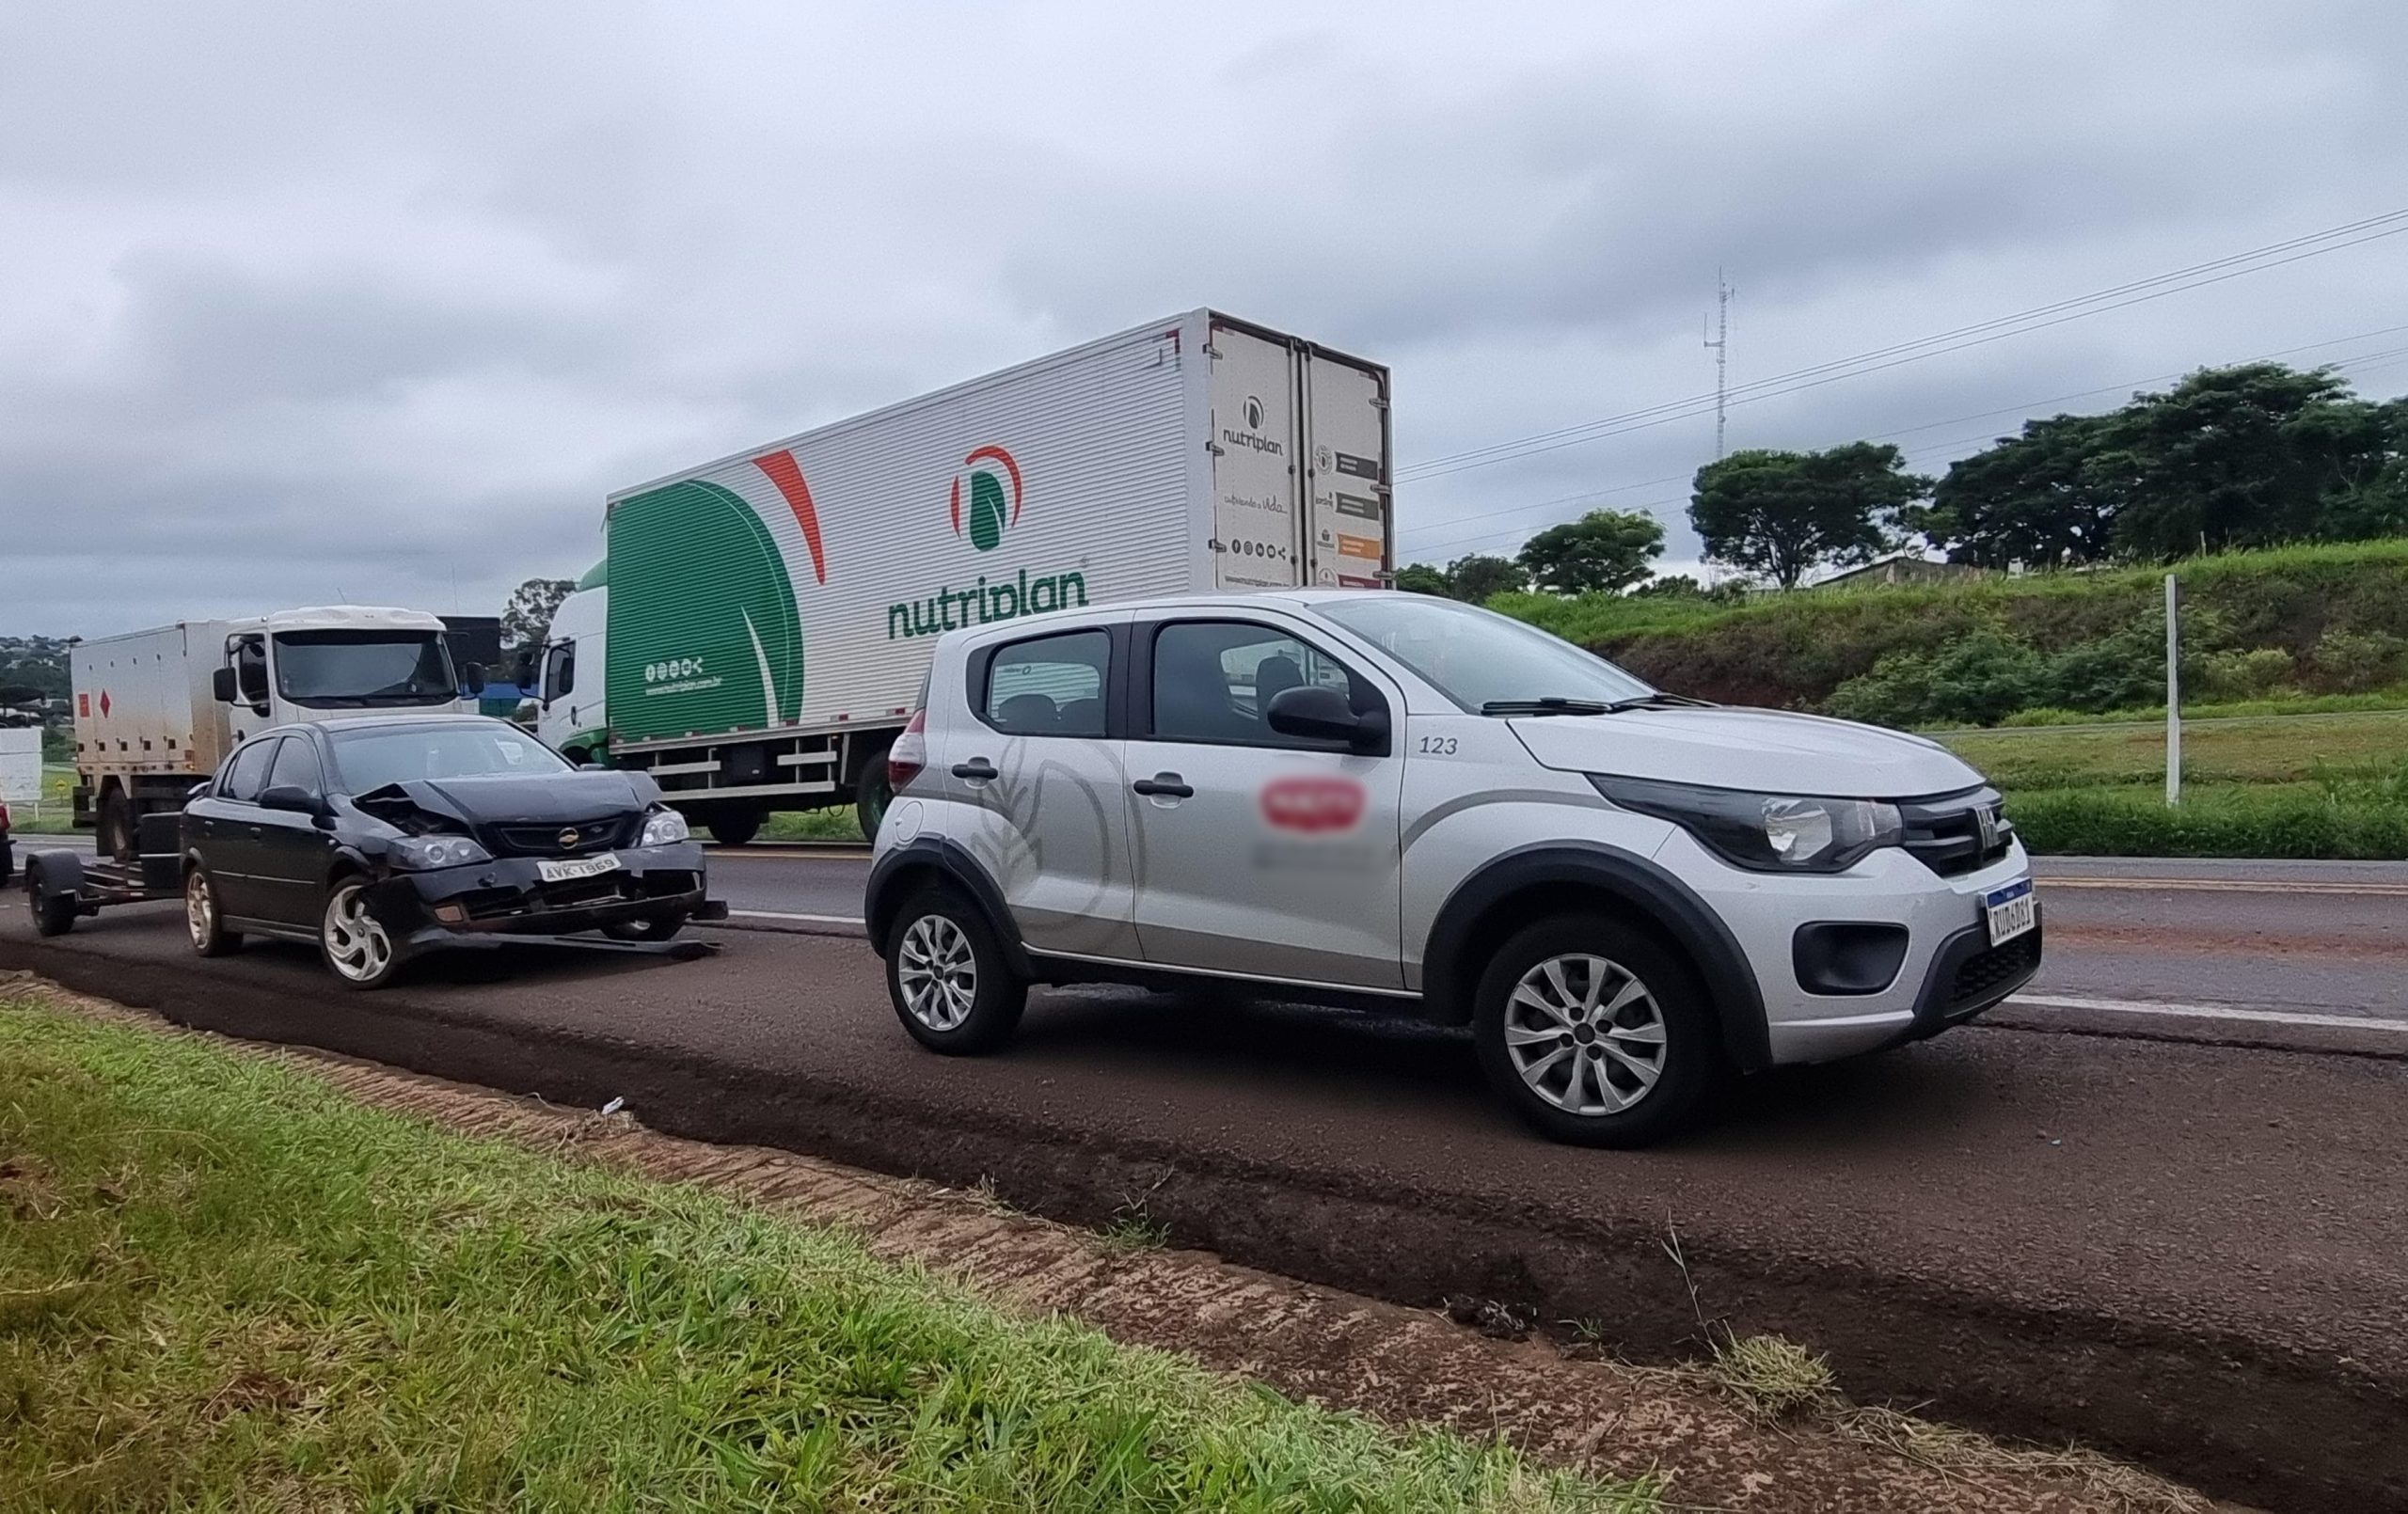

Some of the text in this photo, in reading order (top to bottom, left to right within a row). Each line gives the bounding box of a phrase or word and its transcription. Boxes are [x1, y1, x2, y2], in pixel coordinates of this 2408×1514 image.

[1223, 429, 1283, 456] nutriplan
[888, 568, 1089, 640] nutriplan
[1418, 735, 1458, 755] 123
